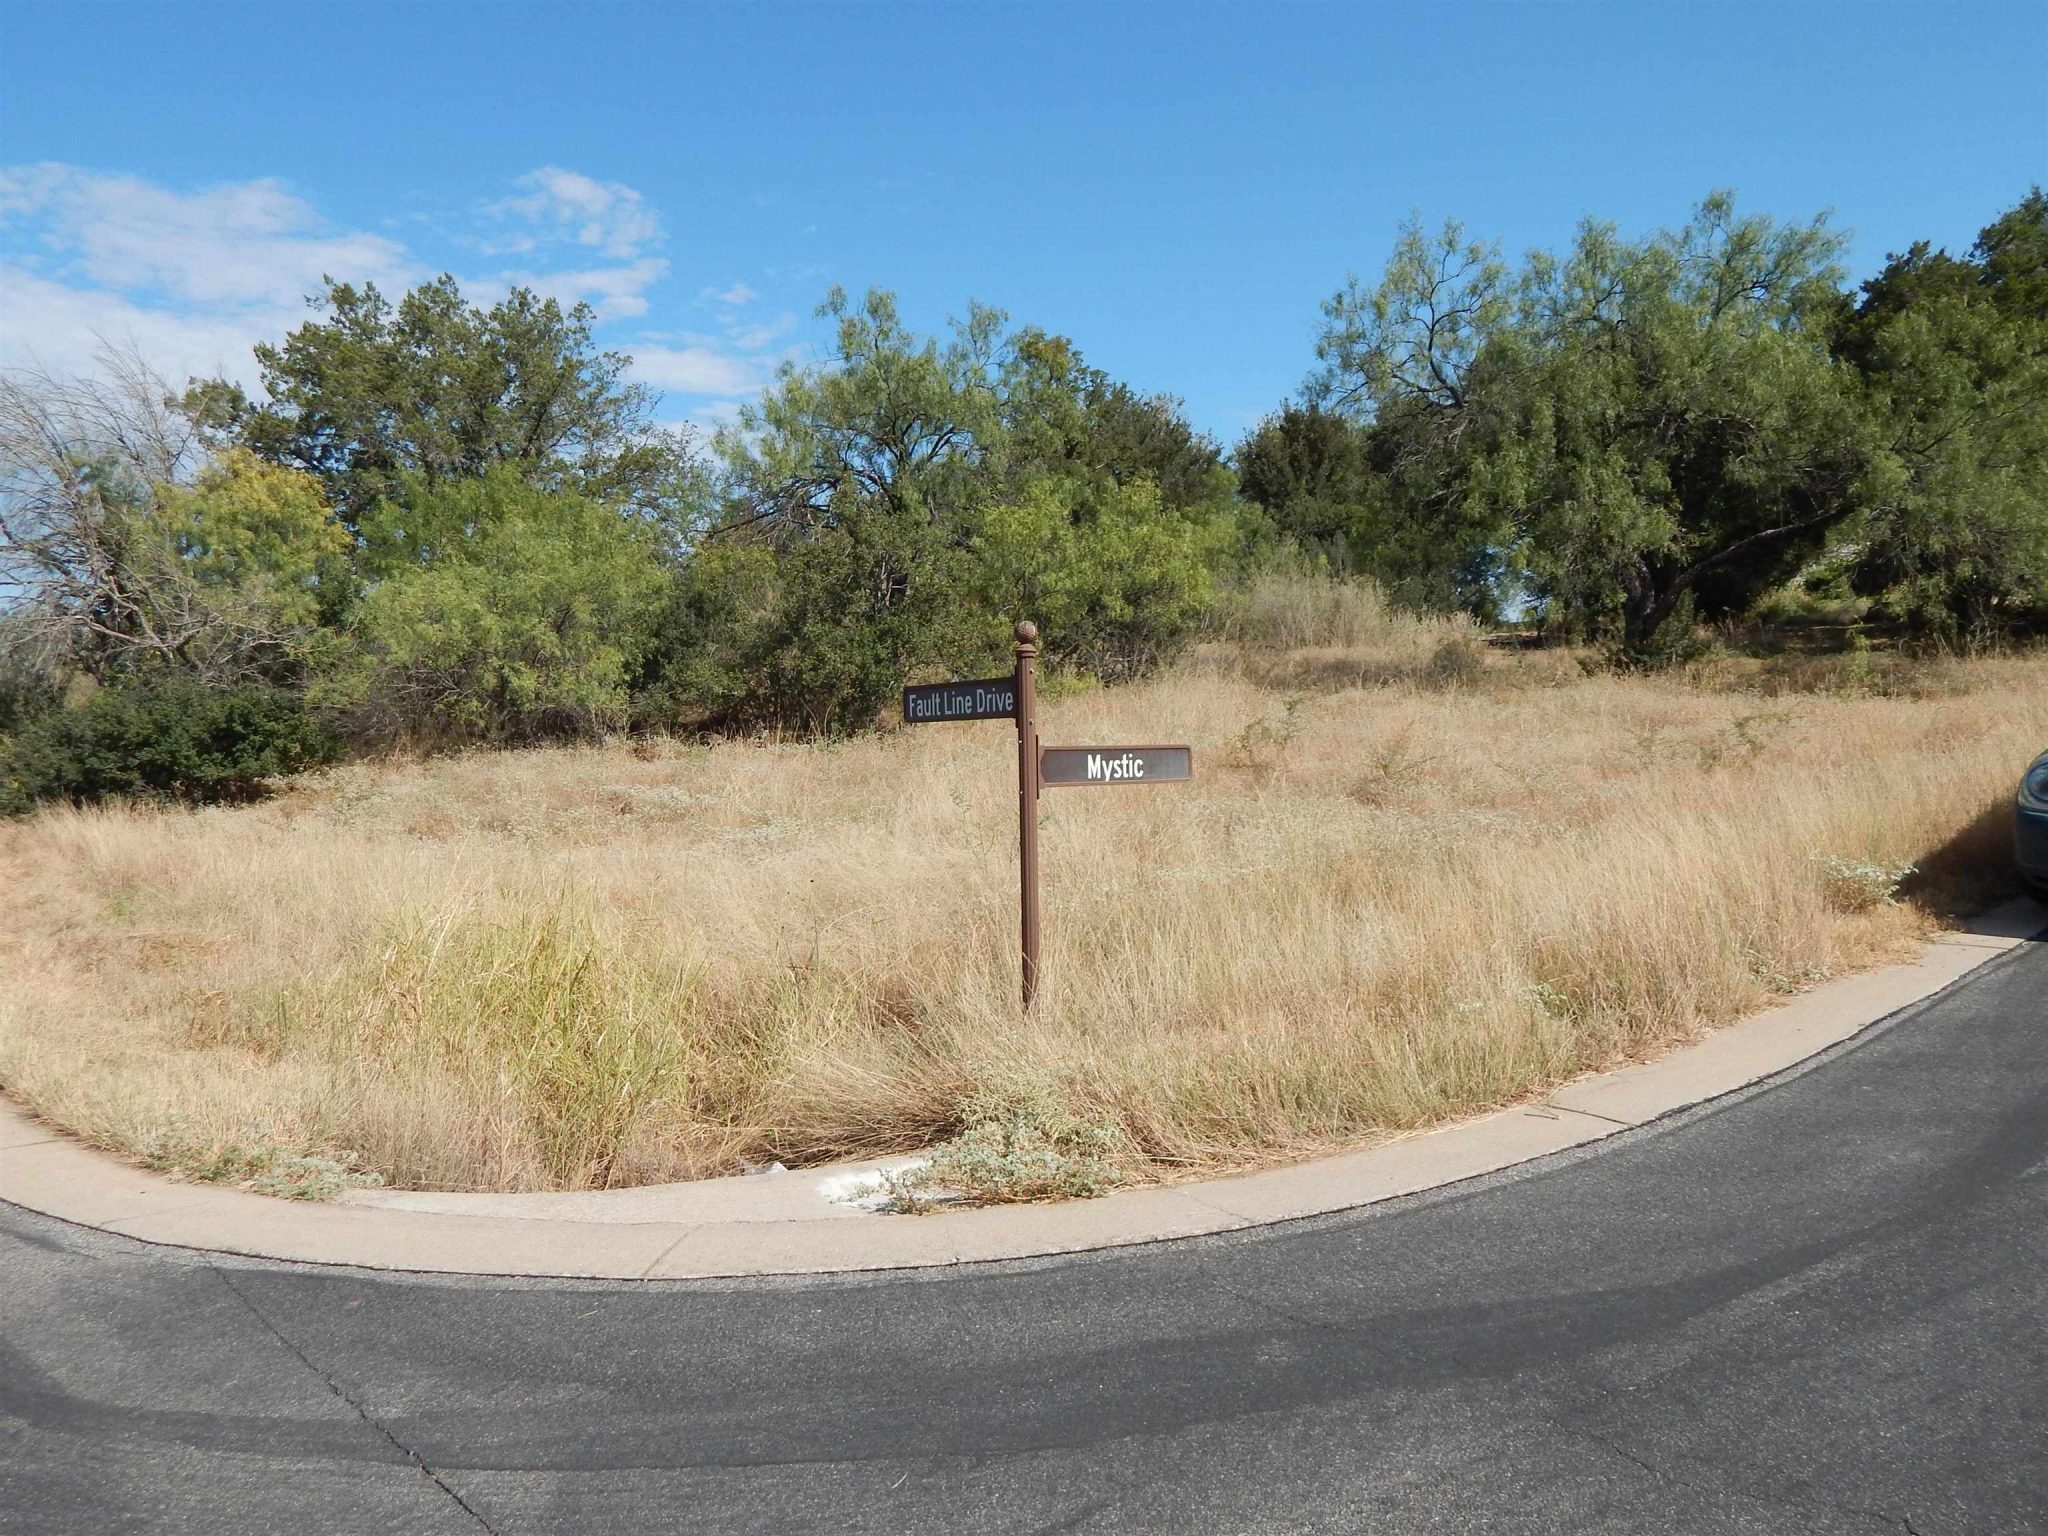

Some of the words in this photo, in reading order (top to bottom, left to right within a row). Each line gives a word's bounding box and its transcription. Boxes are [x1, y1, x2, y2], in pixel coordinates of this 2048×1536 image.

[909, 693, 940, 717] Fault
[944, 691, 972, 715] Line
[976, 687, 1014, 713] Drive
[1087, 753, 1144, 782] Mystic
